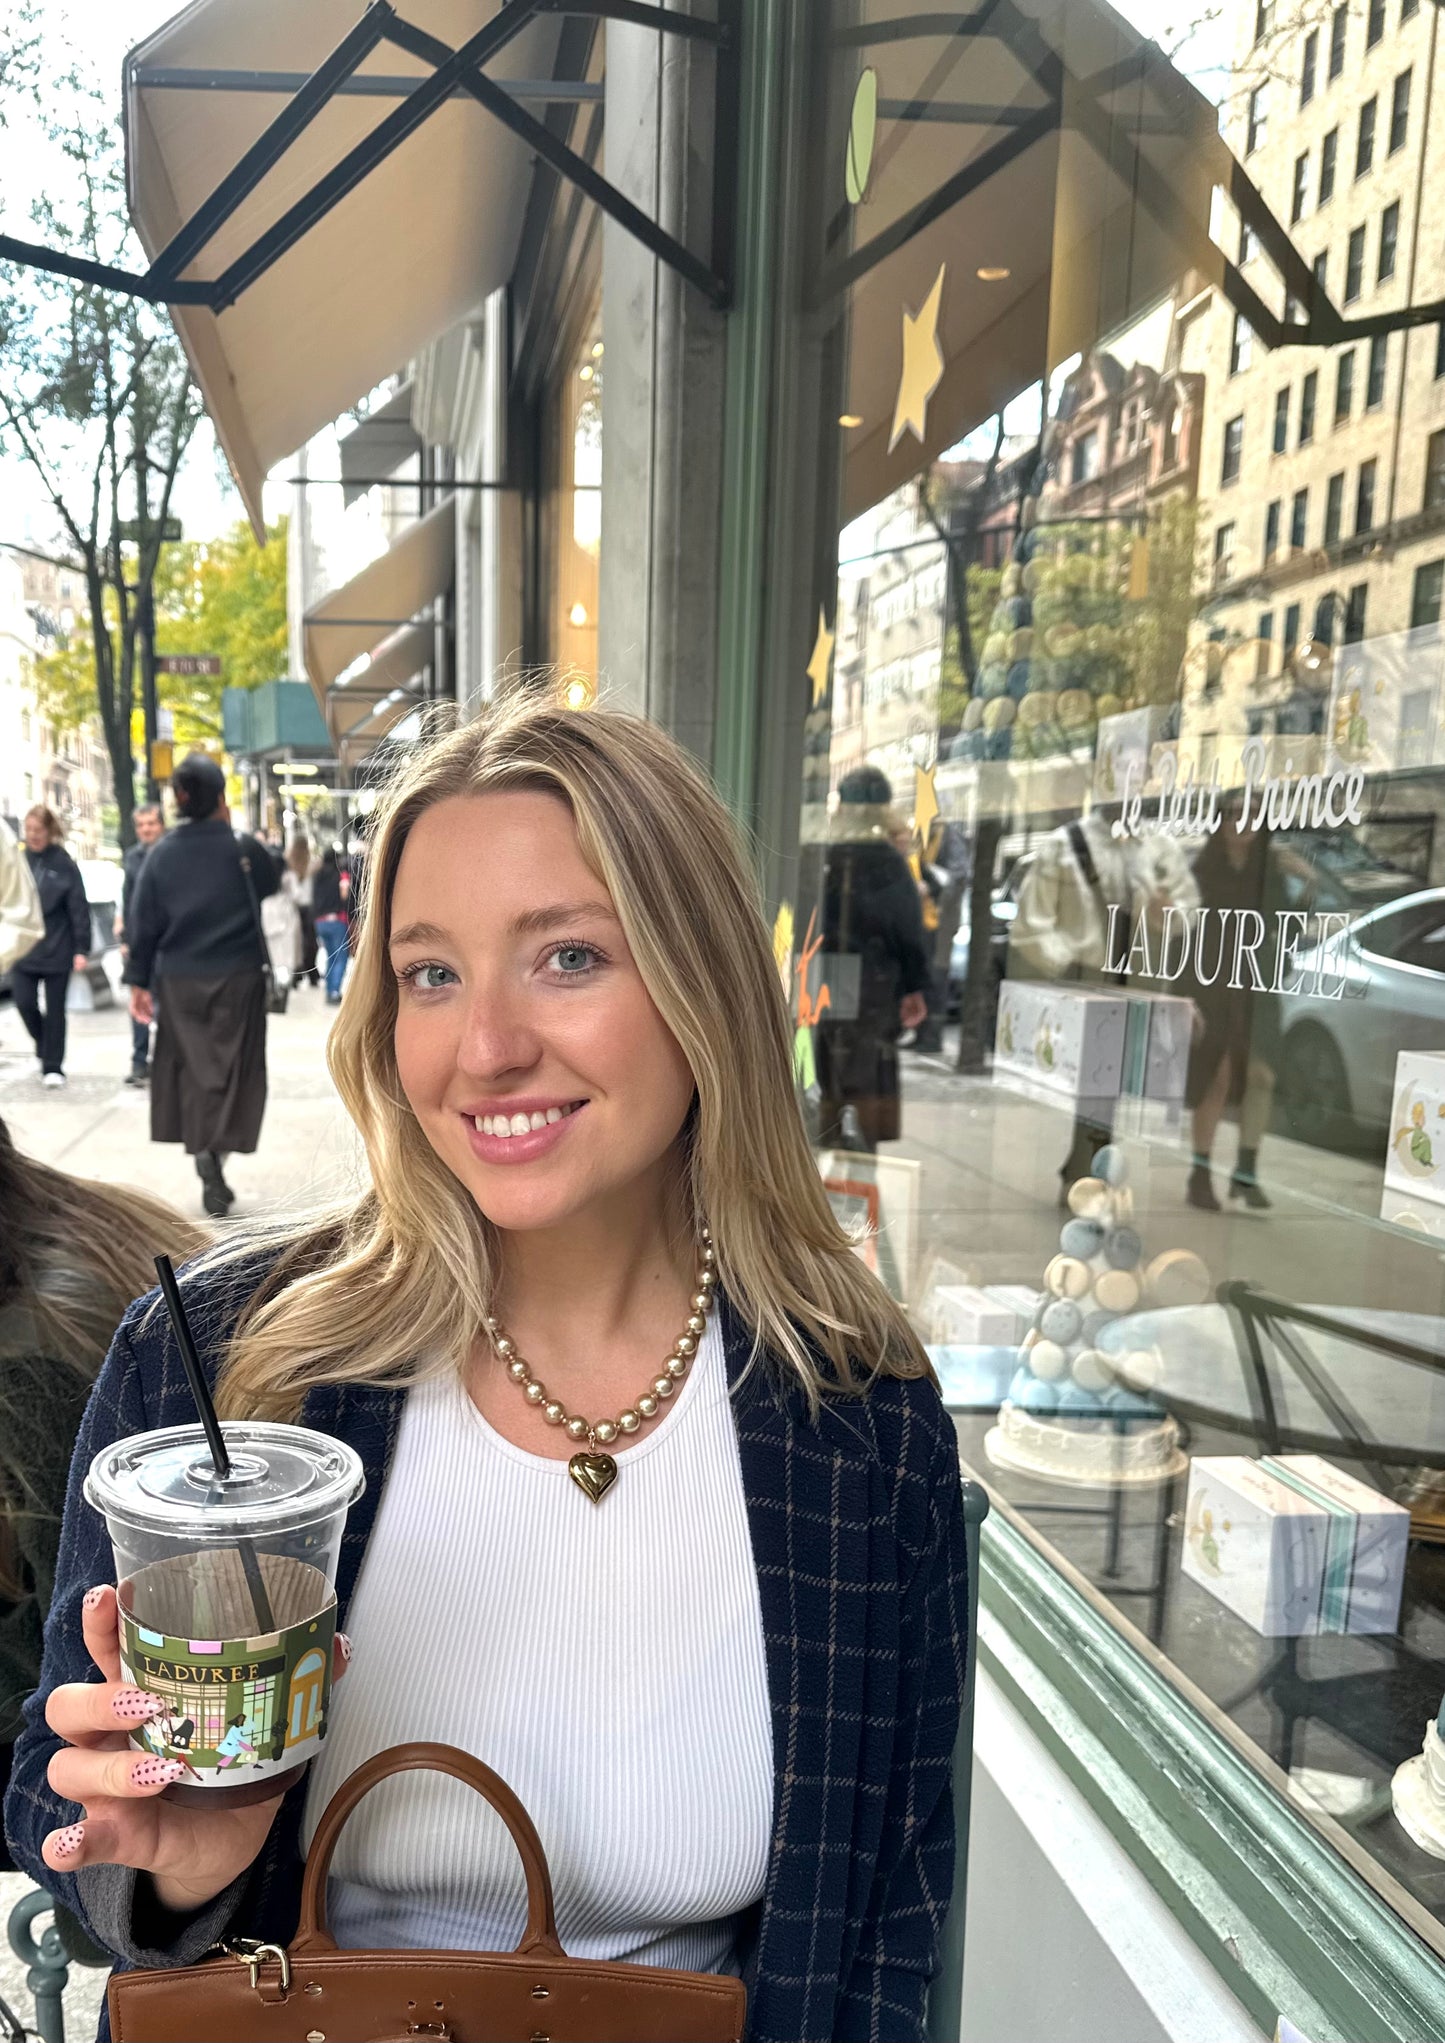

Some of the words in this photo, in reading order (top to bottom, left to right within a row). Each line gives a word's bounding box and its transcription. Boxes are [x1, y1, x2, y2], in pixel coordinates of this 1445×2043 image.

[1111, 759, 1142, 838] Le
[1155, 751, 1222, 834] Petit
[1236, 738, 1365, 833] Prince
[1101, 904, 1350, 1000] LADUREE
[144, 1657, 259, 1683] LADUREE
